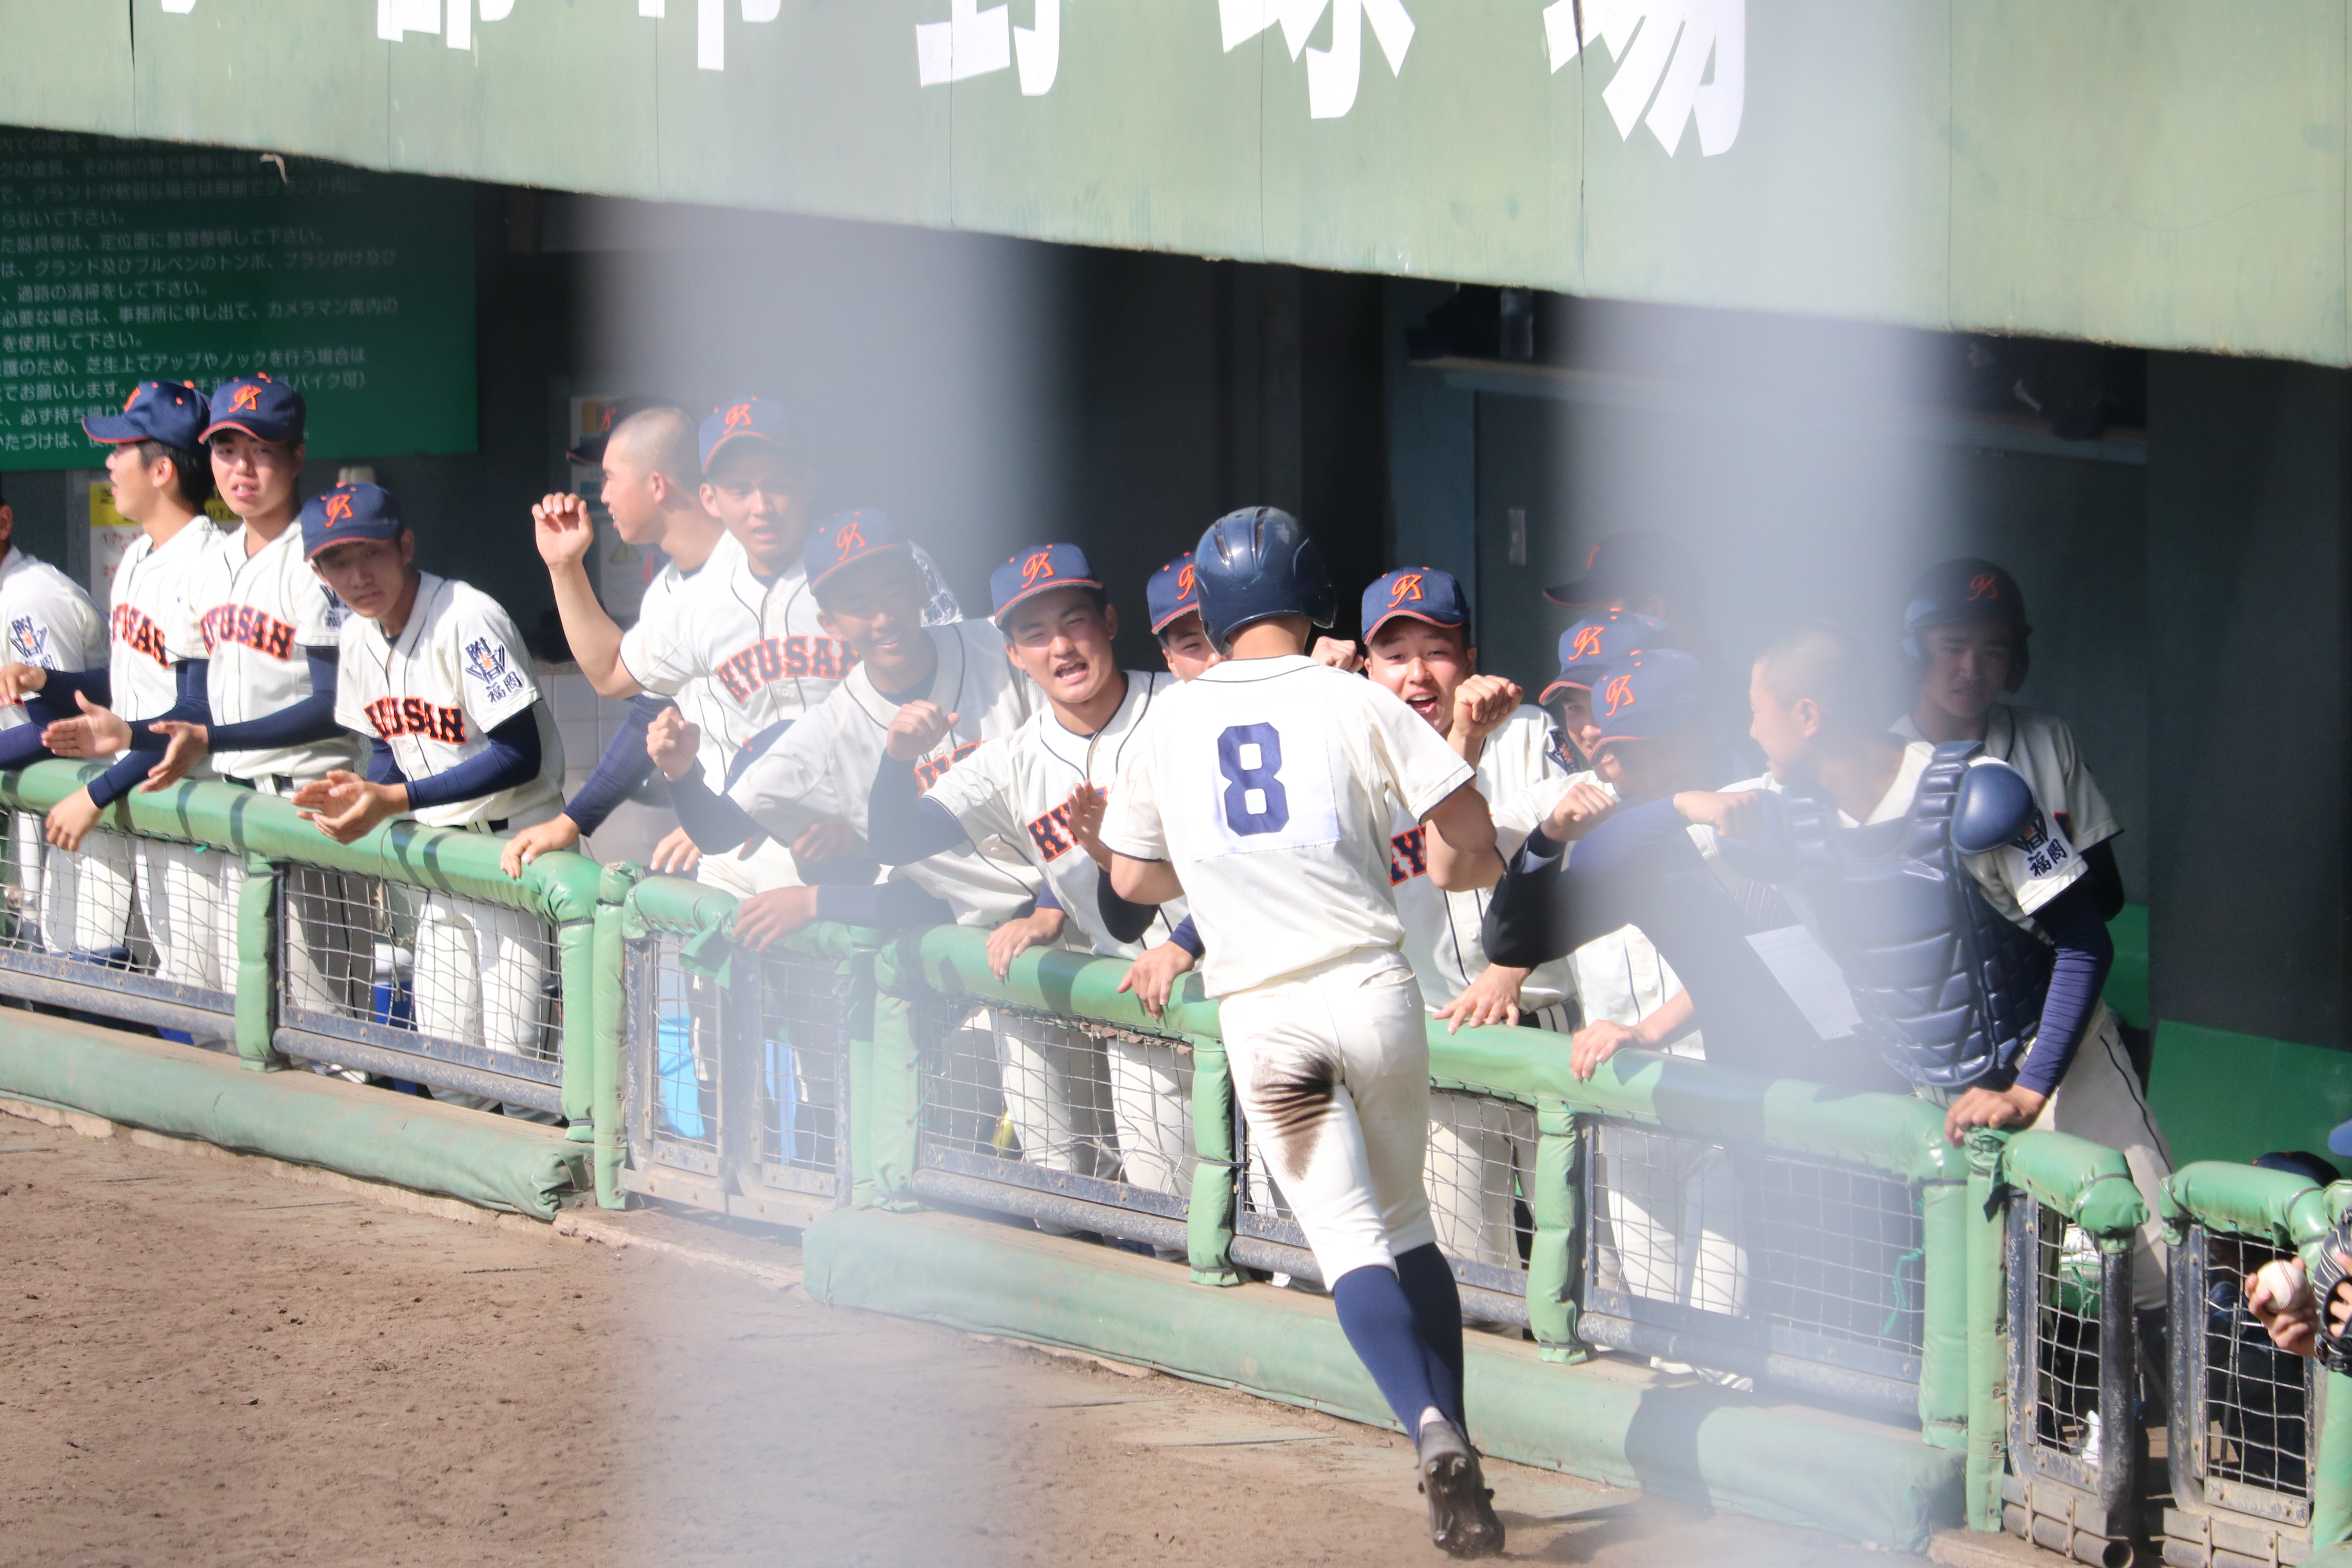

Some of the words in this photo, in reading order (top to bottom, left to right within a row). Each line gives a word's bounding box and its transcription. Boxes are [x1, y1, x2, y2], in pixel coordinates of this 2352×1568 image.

[0, 380, 126, 401] てお願いします。
[485, 671, 524, 703] 福岡
[1217, 722, 1290, 837] 8
[2027, 838, 2068, 877] 福岡
